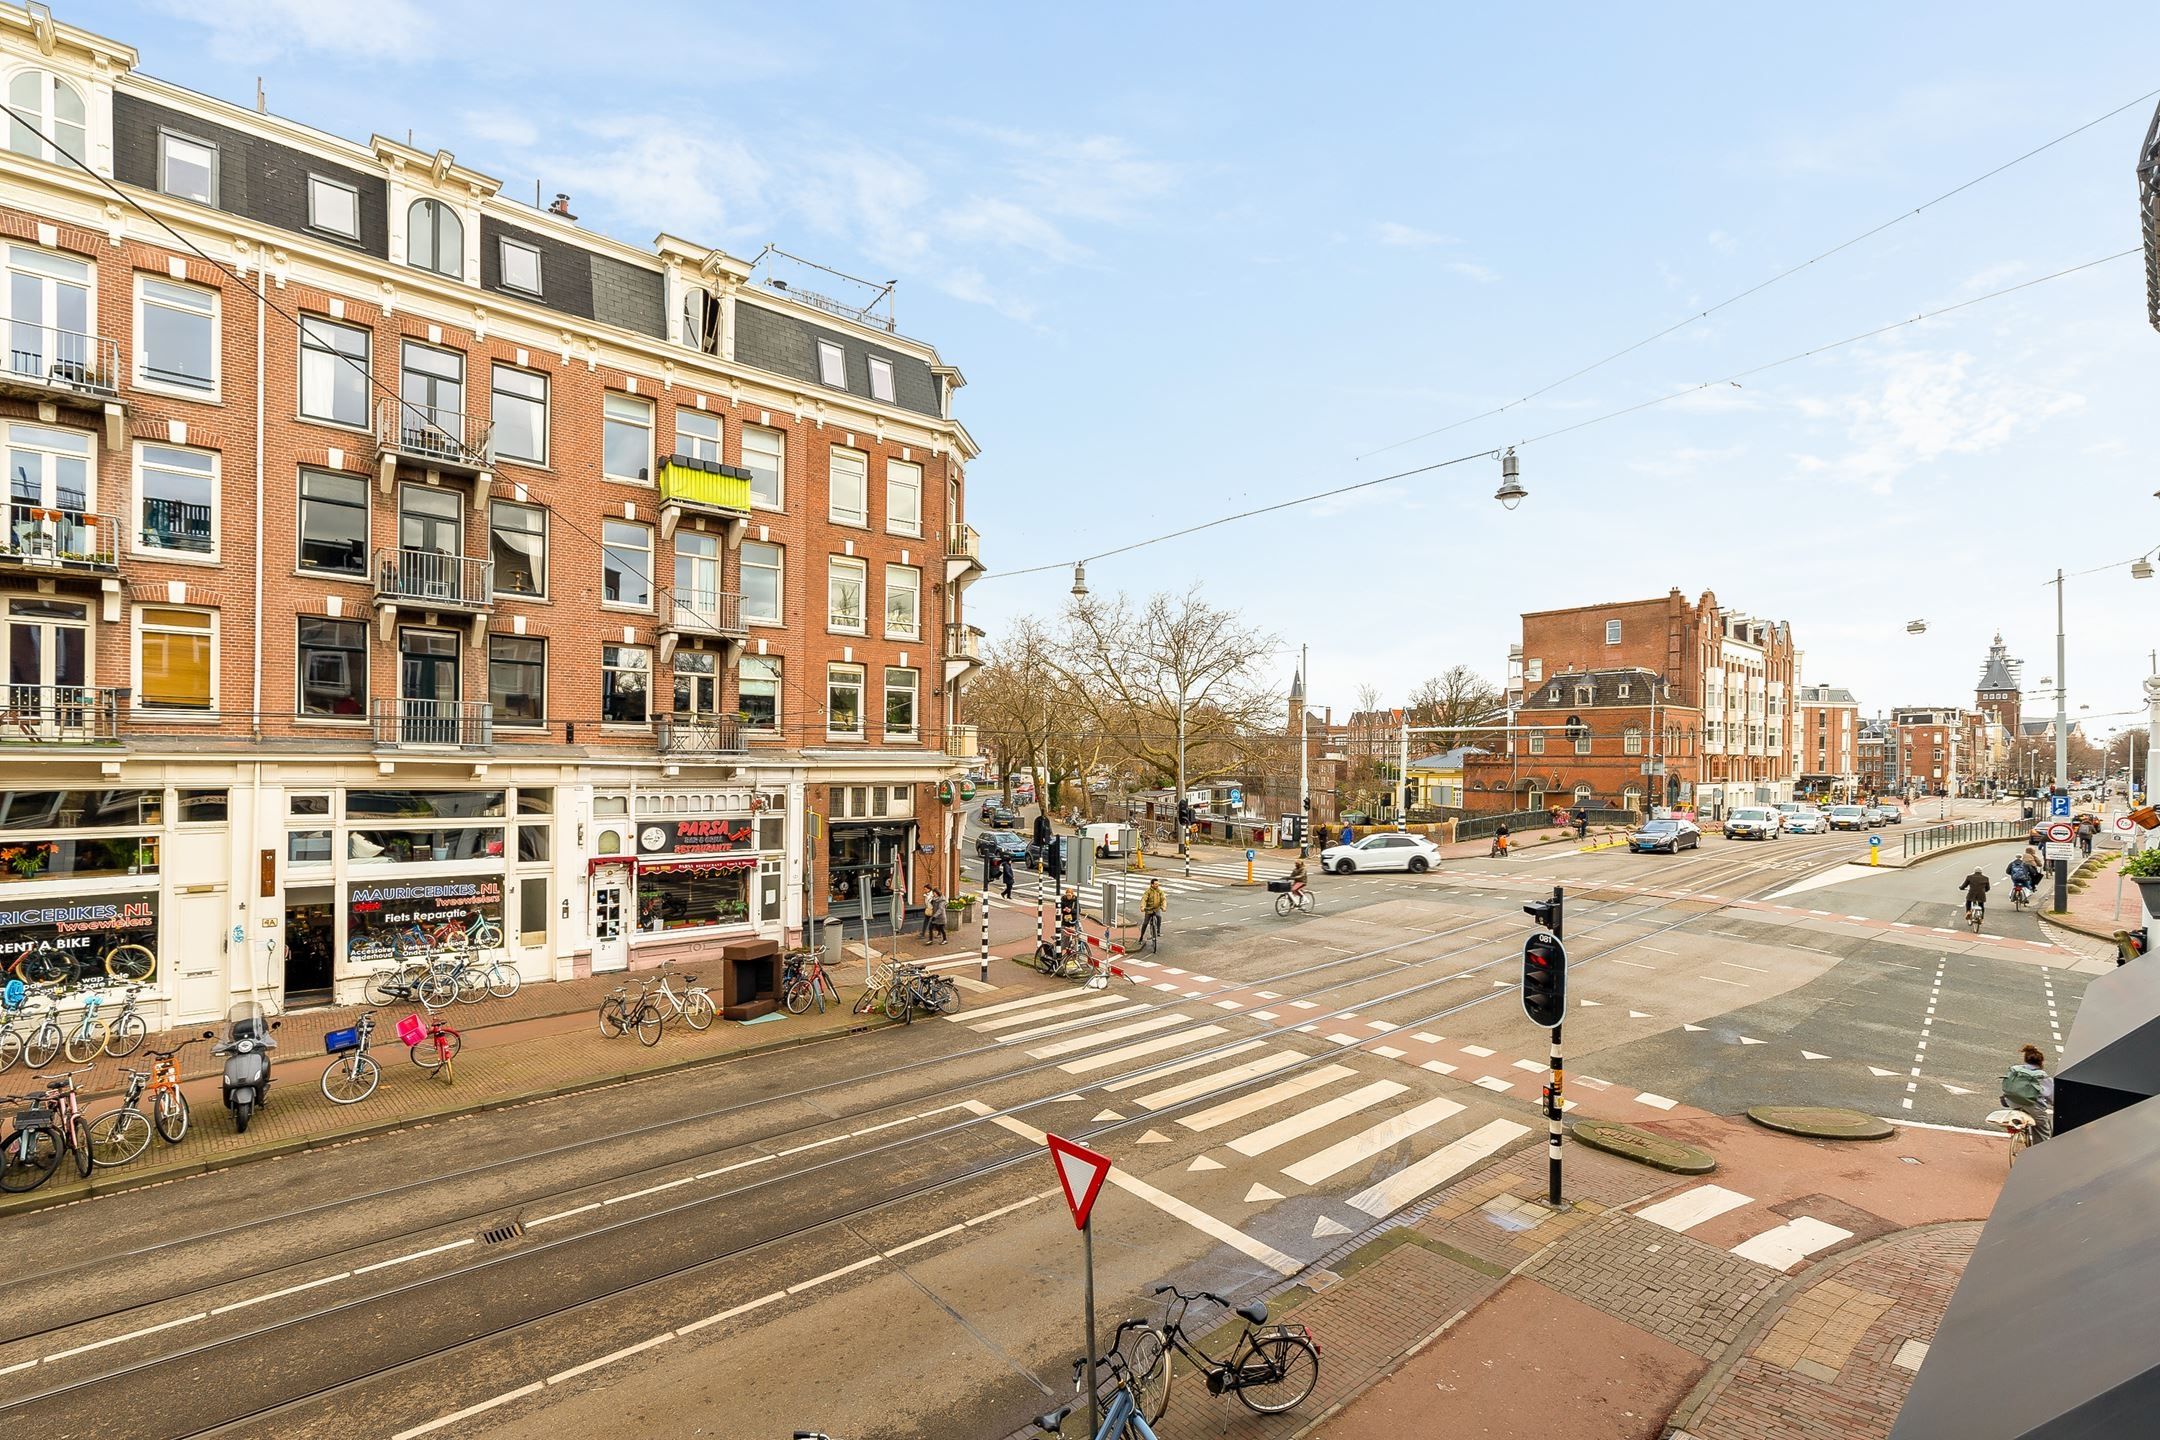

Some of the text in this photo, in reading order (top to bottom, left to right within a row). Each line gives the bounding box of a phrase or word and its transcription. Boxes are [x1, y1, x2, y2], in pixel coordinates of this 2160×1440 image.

[2056, 798, 2066, 808] P
[677, 820, 729, 836] PARSA
[674, 843, 732, 854] RESTAURANTE
[352, 883, 500, 902] MAURICEBIKES.NL
[435, 895, 500, 907] Tweewielers
[561, 898, 569, 906] 4
[385, 909, 467, 922] Fiets Reparatie
[56, 917, 152, 933] Tweewielers
[39, 940, 51, 951] A
[57, 937, 90, 949] BIKE
[1539, 934, 1552, 943] 081
[350, 947, 396, 955] Accessoires
